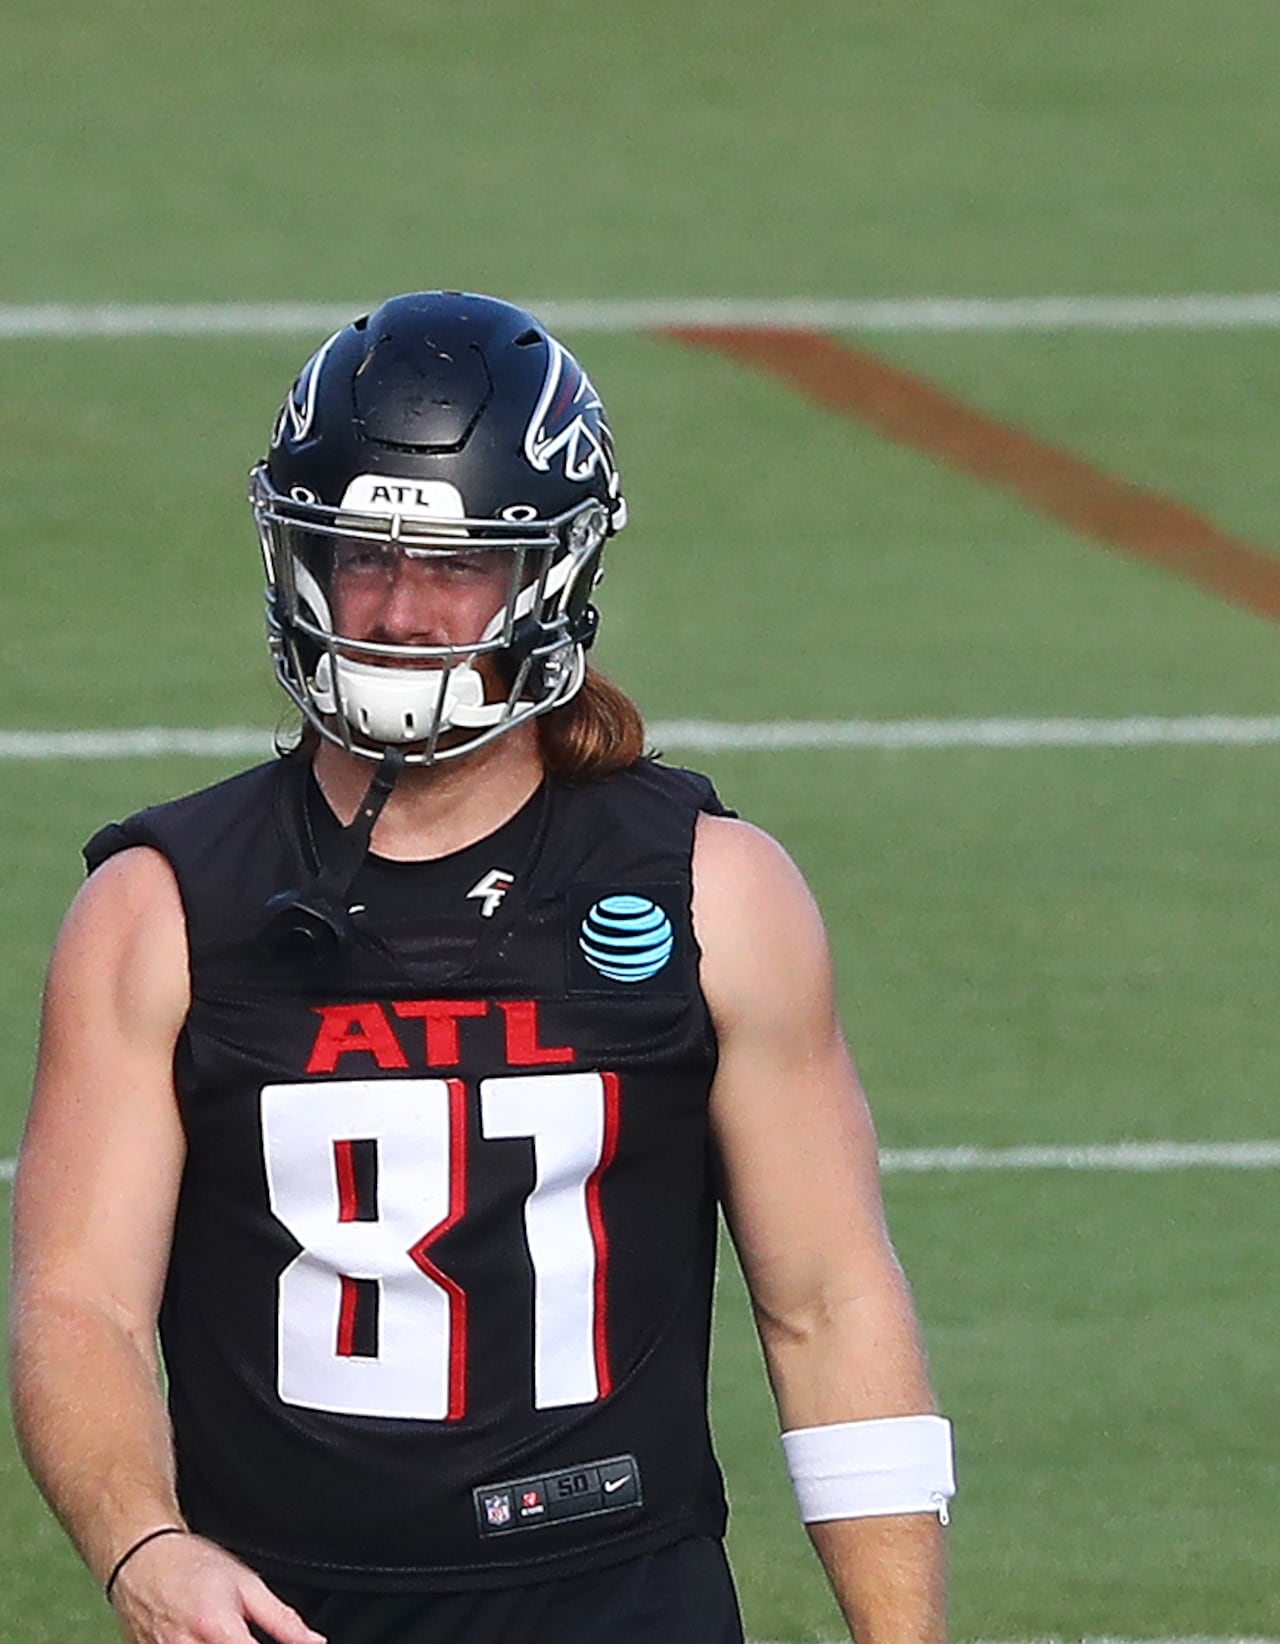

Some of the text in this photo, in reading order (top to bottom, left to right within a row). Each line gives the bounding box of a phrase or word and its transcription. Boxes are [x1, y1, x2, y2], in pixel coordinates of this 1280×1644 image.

[370, 485, 429, 507] ATL
[306, 999, 577, 1073] ATL
[260, 1071, 621, 1421] 81
